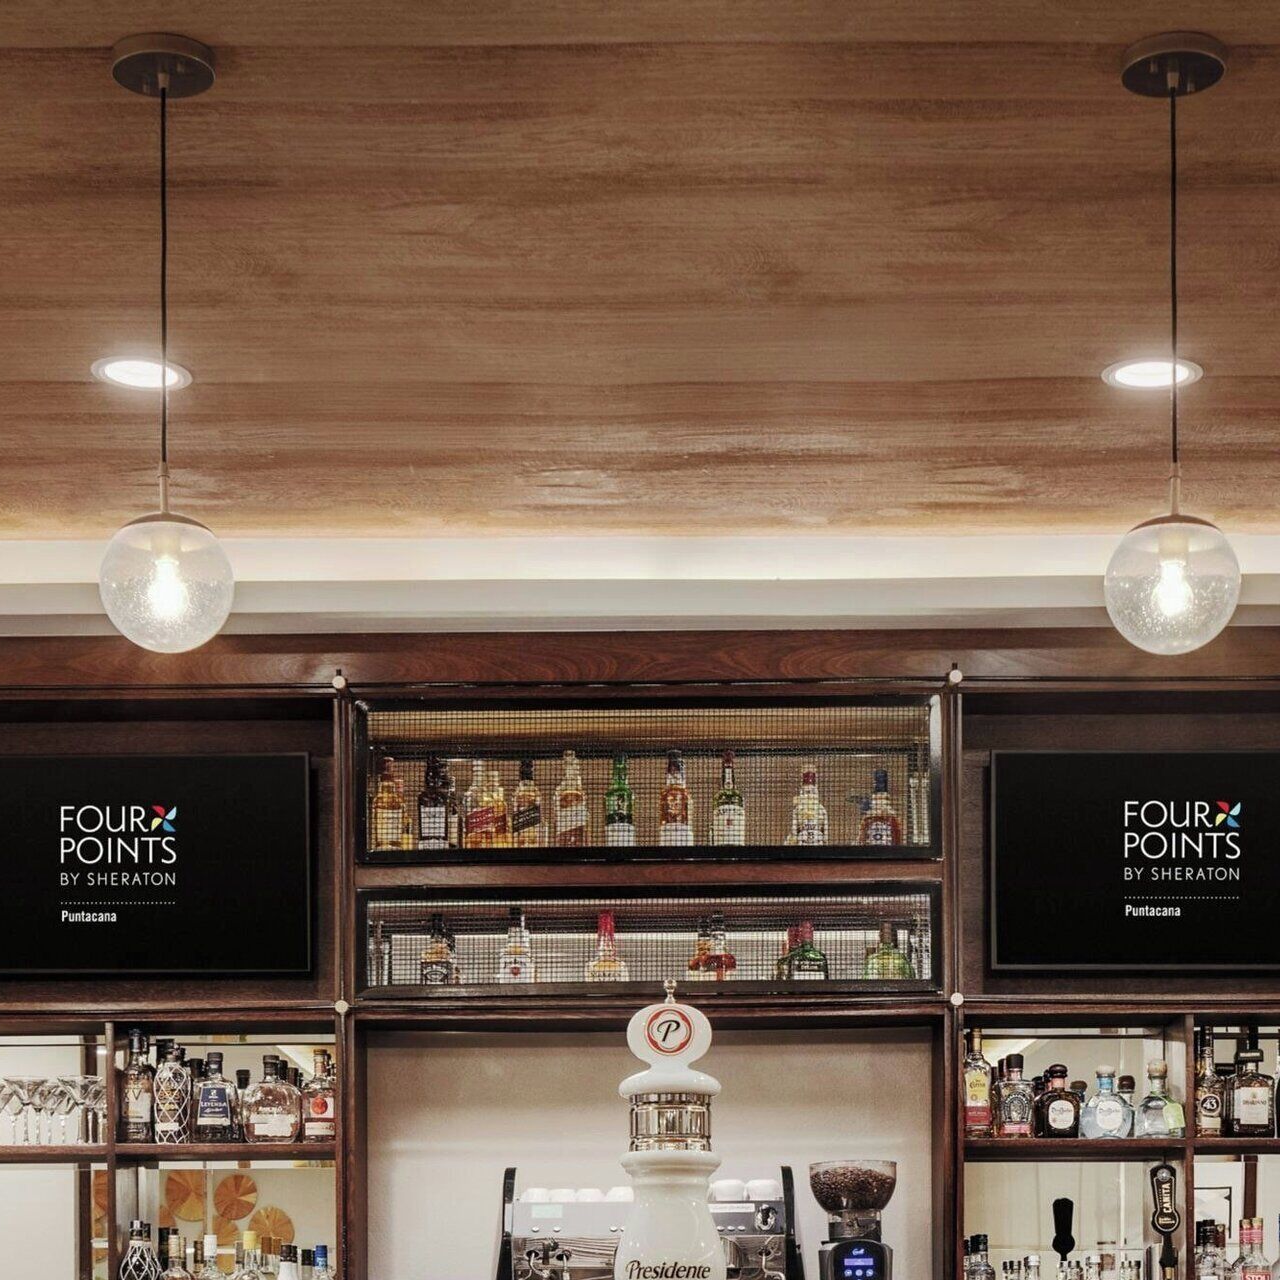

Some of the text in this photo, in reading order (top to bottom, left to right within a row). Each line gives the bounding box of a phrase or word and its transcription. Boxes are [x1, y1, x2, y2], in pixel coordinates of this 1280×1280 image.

[60, 804, 150, 833] FOUR
[1124, 800, 1214, 828] FOUR
[60, 836, 177, 864] POINTS
[1124, 831, 1241, 859] POINTS
[60, 872, 176, 886] BY SHERATON
[1124, 867, 1240, 881] BY SHERATON
[61, 910, 117, 922] Puntacana
[1125, 904, 1181, 917] Puntacana
[656, 1020, 681, 1042] P
[1202, 1099, 1218, 1110] 43
[625, 1260, 711, 1280] Presidente
